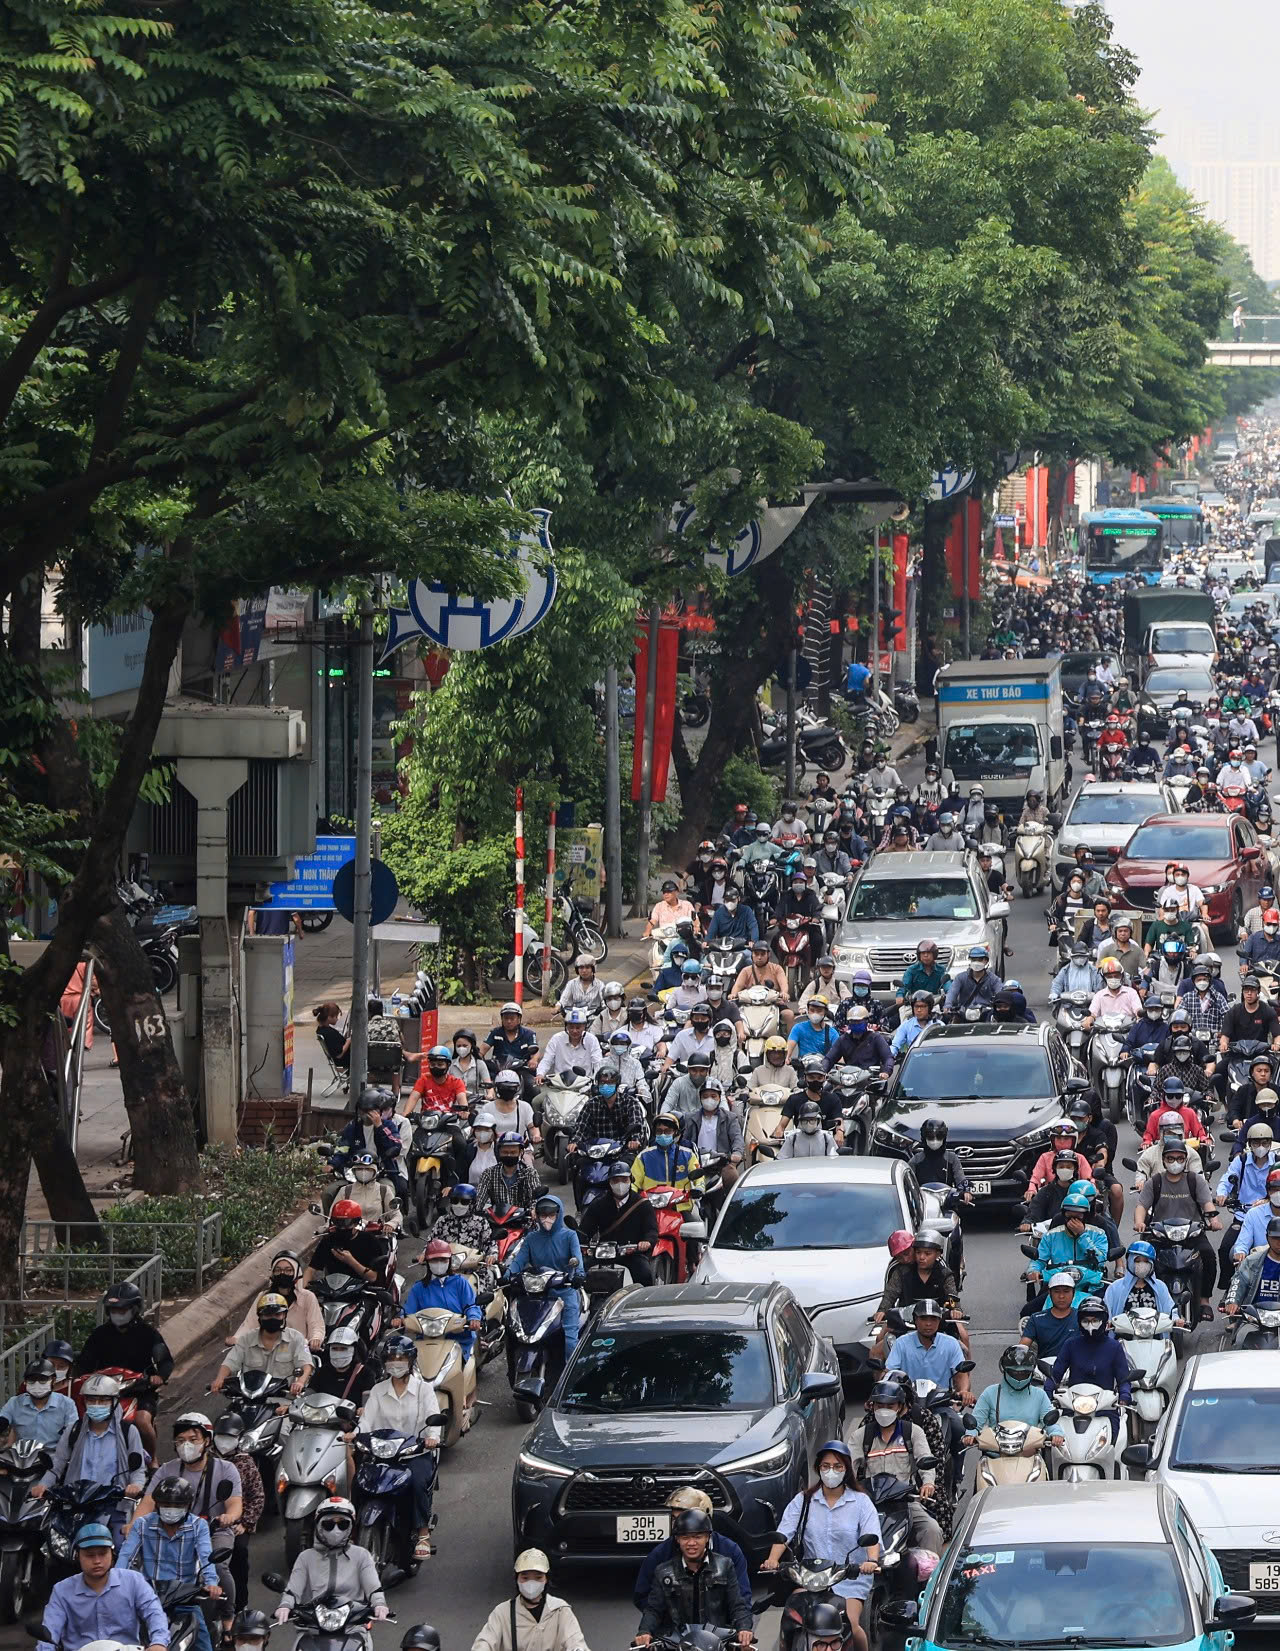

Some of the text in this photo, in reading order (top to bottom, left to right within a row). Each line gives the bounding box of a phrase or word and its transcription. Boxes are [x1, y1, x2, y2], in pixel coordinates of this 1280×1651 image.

[966, 685, 1021, 699] XE THƯ BÁO
[135, 1015, 165, 1043] 163
[971, 1183, 990, 1193] 5.61
[631, 1517, 655, 1528] 30H
[622, 1529, 664, 1541] 309.52
[963, 1564, 995, 1578] TAXI
